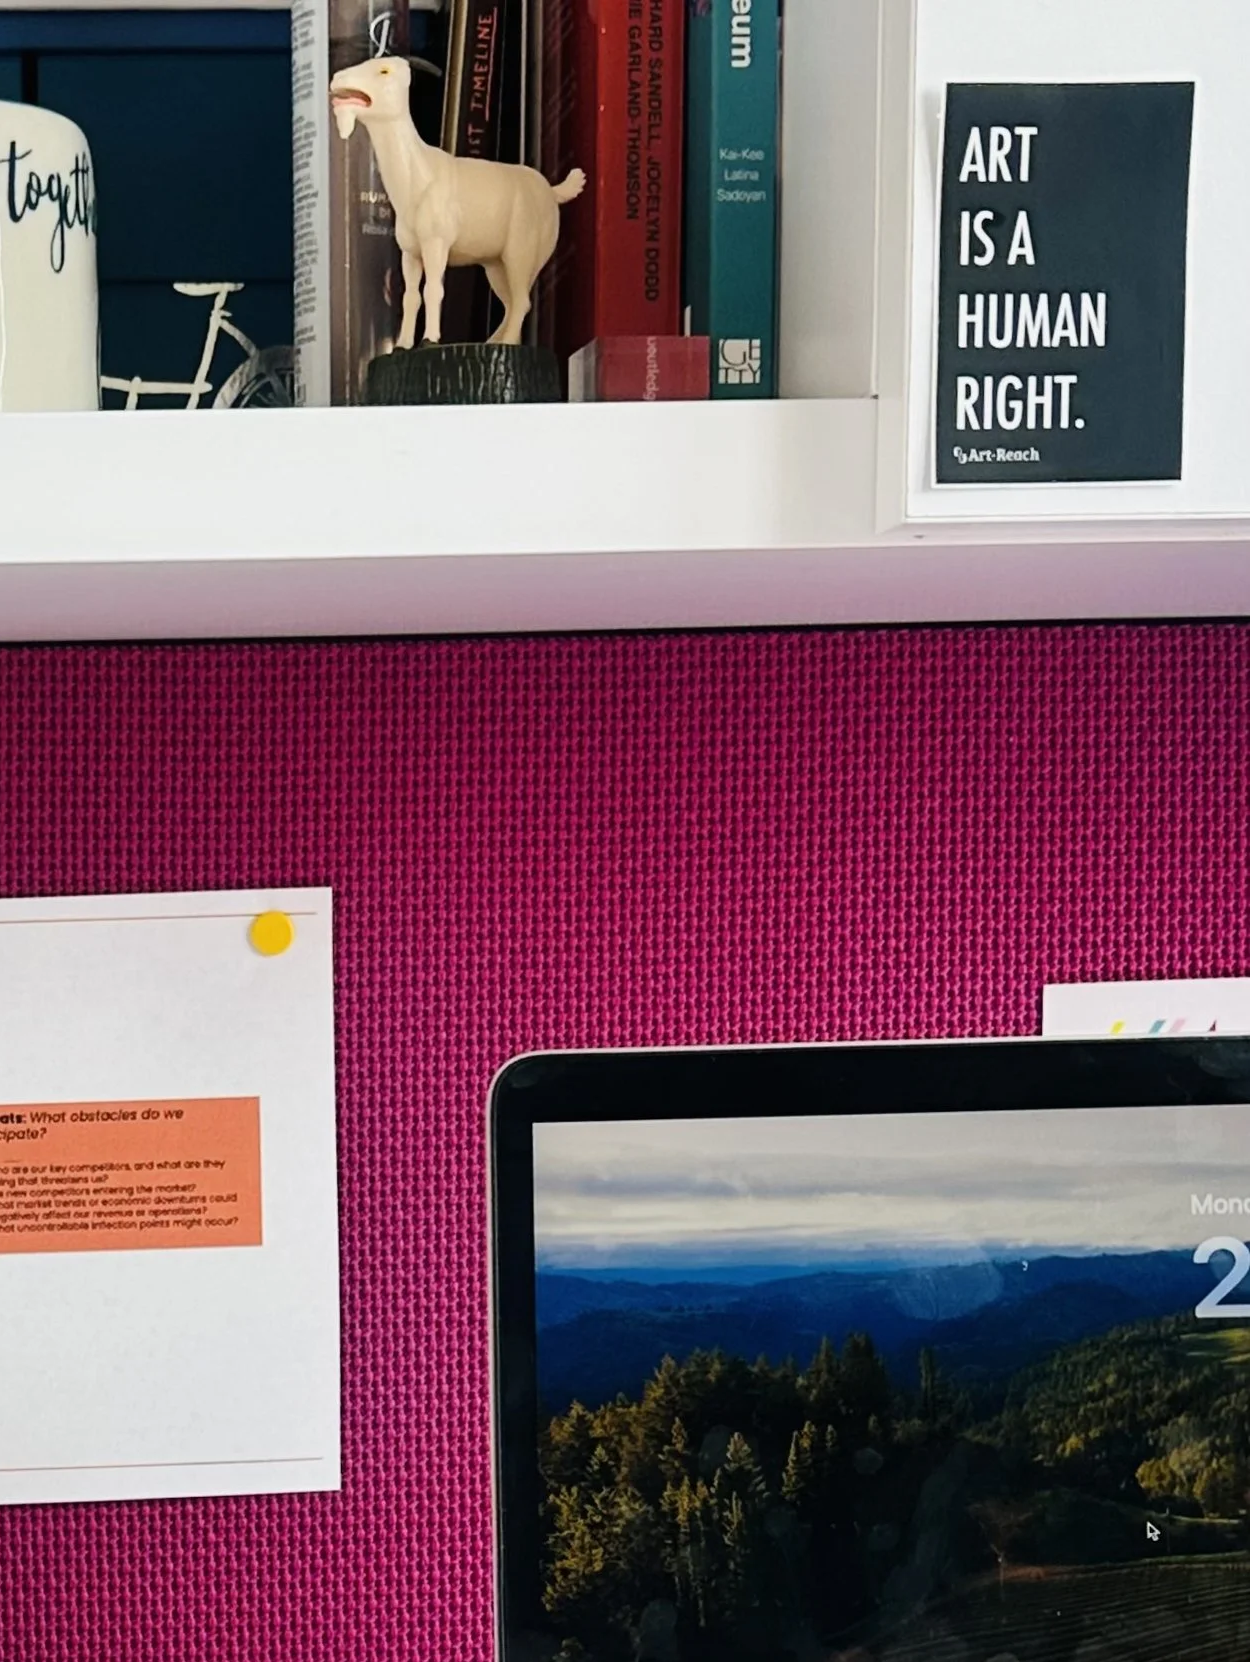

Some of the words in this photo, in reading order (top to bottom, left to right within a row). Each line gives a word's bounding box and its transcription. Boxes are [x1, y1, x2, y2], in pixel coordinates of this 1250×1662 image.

[625, 25, 643, 220] GARLAND-THOMSON
[718, 147, 765, 161] Kai-Kee
[723, 168, 759, 182] Latina
[958, 126, 1039, 183] ART
[644, 156, 662, 244] JOCELYN
[716, 188, 767, 203] Sadoyan
[959, 209, 996, 266] IS
[1007, 210, 1036, 266] A
[643, 247, 661, 304] DODD
[957, 292, 1107, 349] HUMAN
[955, 375, 1086, 431] RIGHT.
[967, 446, 1041, 464] Art-Reach
[29, 1111, 67, 1124] What
[69, 1107, 138, 1124] obstacles
[141, 1107, 161, 1121] do
[162, 1108, 185, 1120] we
